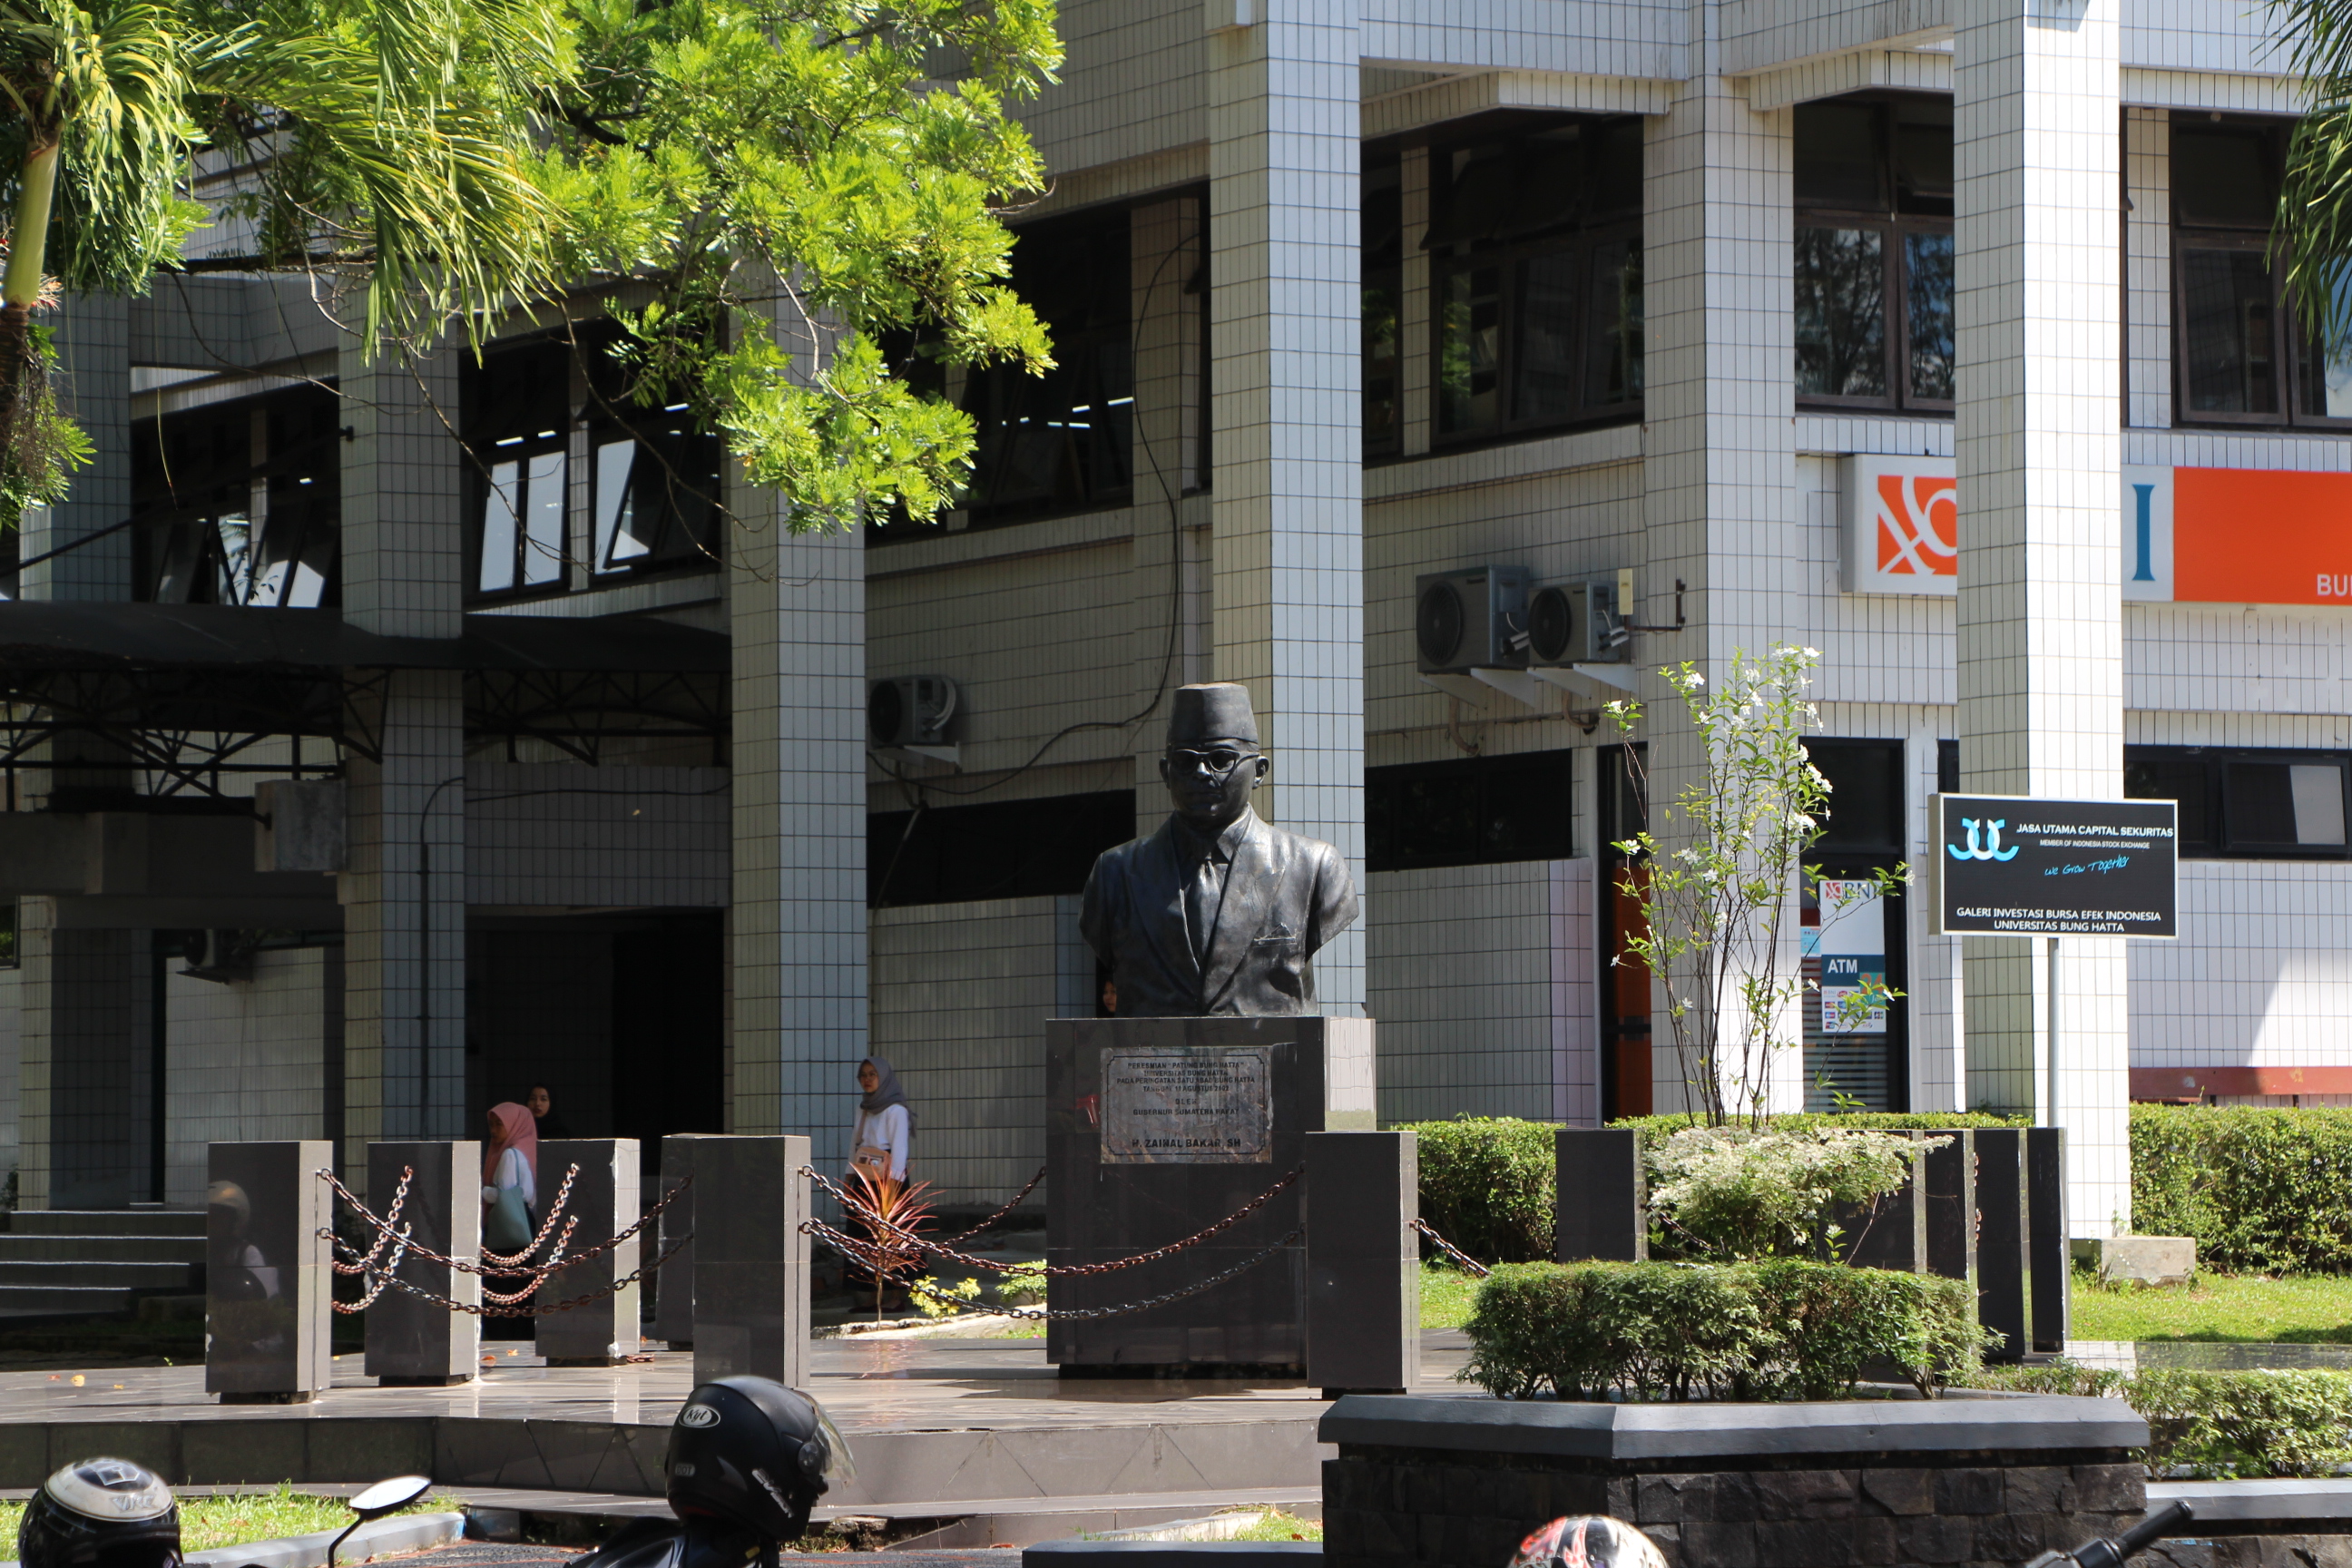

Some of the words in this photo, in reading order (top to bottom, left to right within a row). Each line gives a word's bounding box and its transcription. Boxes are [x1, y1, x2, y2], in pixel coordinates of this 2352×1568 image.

[2317, 573, 2352, 597] BU
[2016, 823, 2042, 834] JASA
[2042, 824, 2077, 836] UTAMA
[2078, 825, 2119, 837] CAPITAL
[2120, 826, 2173, 838] SEKURITAS
[2073, 839, 2102, 848] INDONESIA
[2102, 840, 2121, 848] STOCK
[2121, 841, 2151, 849] EXCHANGE
[2087, 854, 2130, 876] Together
[1956, 907, 1992, 917] GALERI
[1993, 908, 2043, 919] INVESTASI
[2045, 909, 2079, 920] BURSA
[2081, 910, 2103, 921] EFEK
[2105, 911, 2161, 922] INDONESIA
[1994, 920, 2058, 931] UNIVERSITAS
[2060, 921, 2089, 932] BUNG
[2091, 922, 2125, 933] HATTA
[1828, 958, 1857, 974] ATM
[1174, 1108, 1214, 1116] SUMATERA
[1145, 1138, 1183, 1148] ZAINAL
[1227, 1138, 1241, 1148] SH
